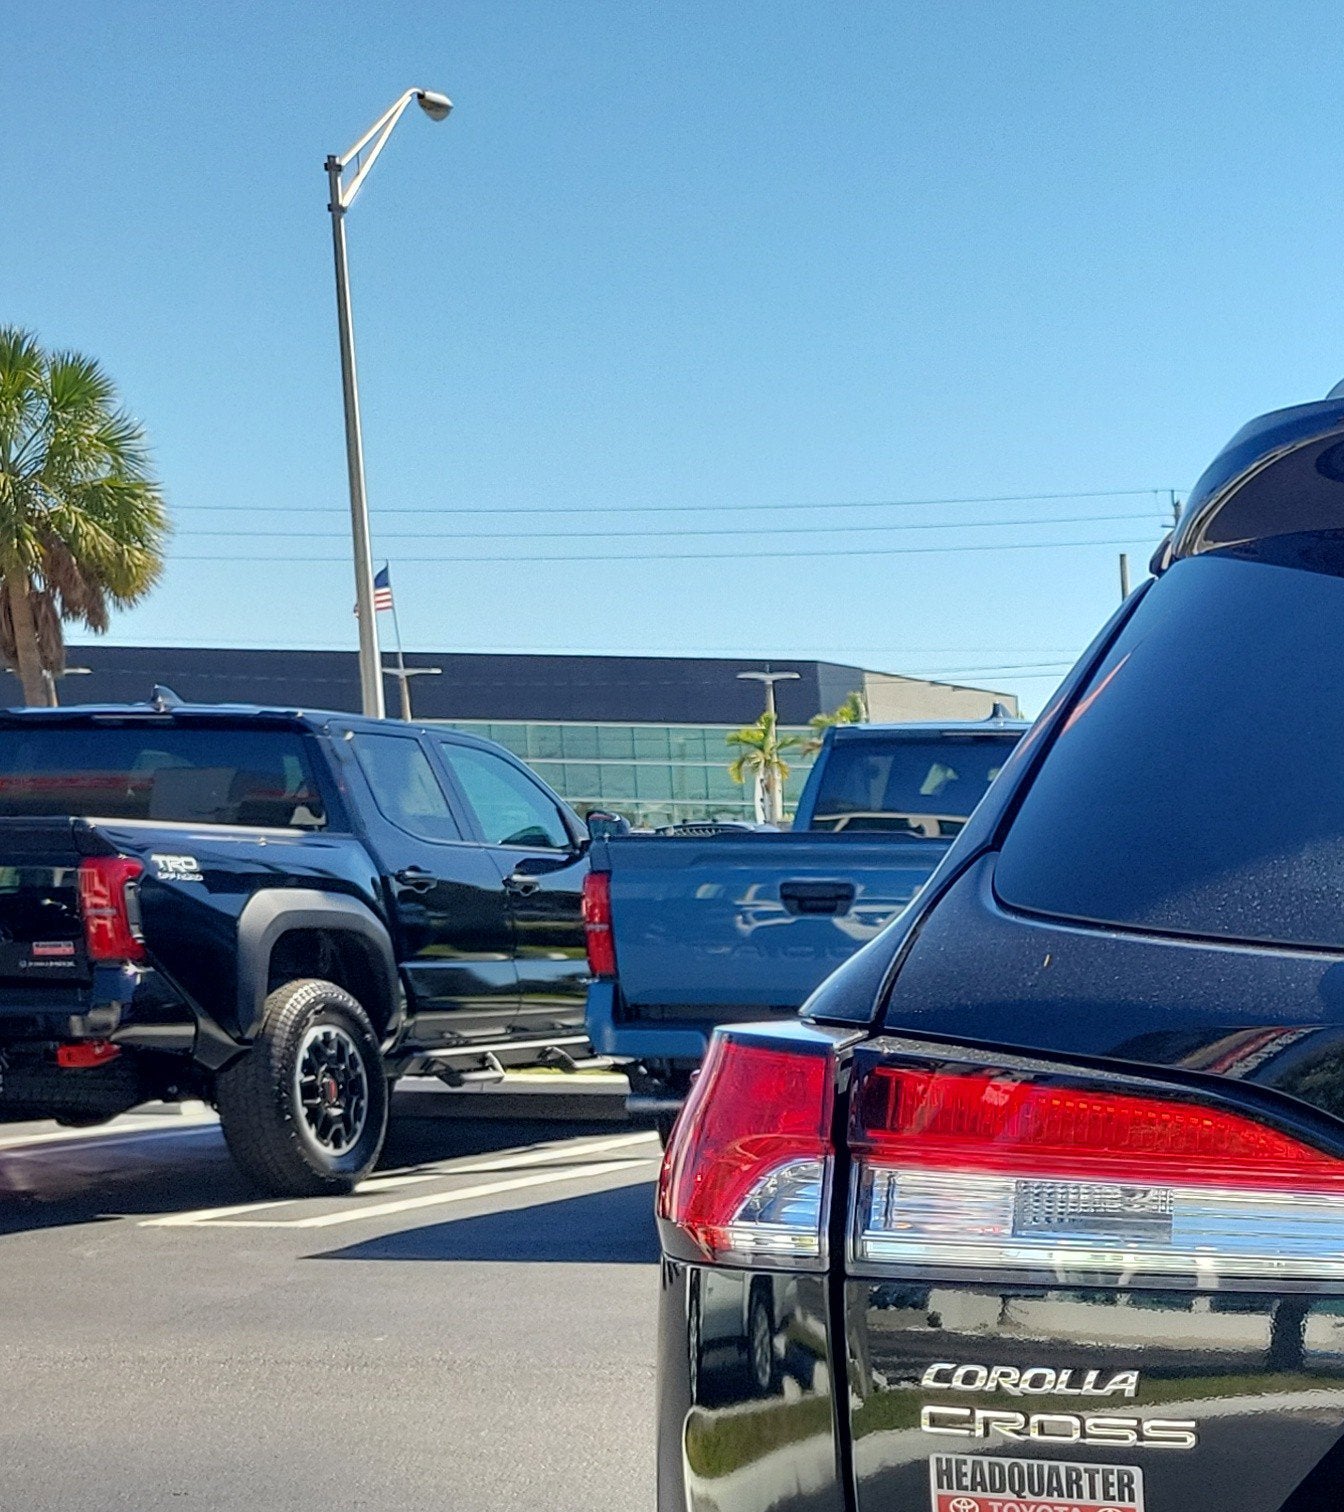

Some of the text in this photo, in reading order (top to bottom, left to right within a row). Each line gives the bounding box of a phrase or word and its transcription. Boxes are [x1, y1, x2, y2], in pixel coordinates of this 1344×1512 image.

[920, 1363, 1140, 1397] COROLLA
[920, 1405, 1197, 1450] CROSS
[935, 1456, 1136, 1503] HEADQUARTER
